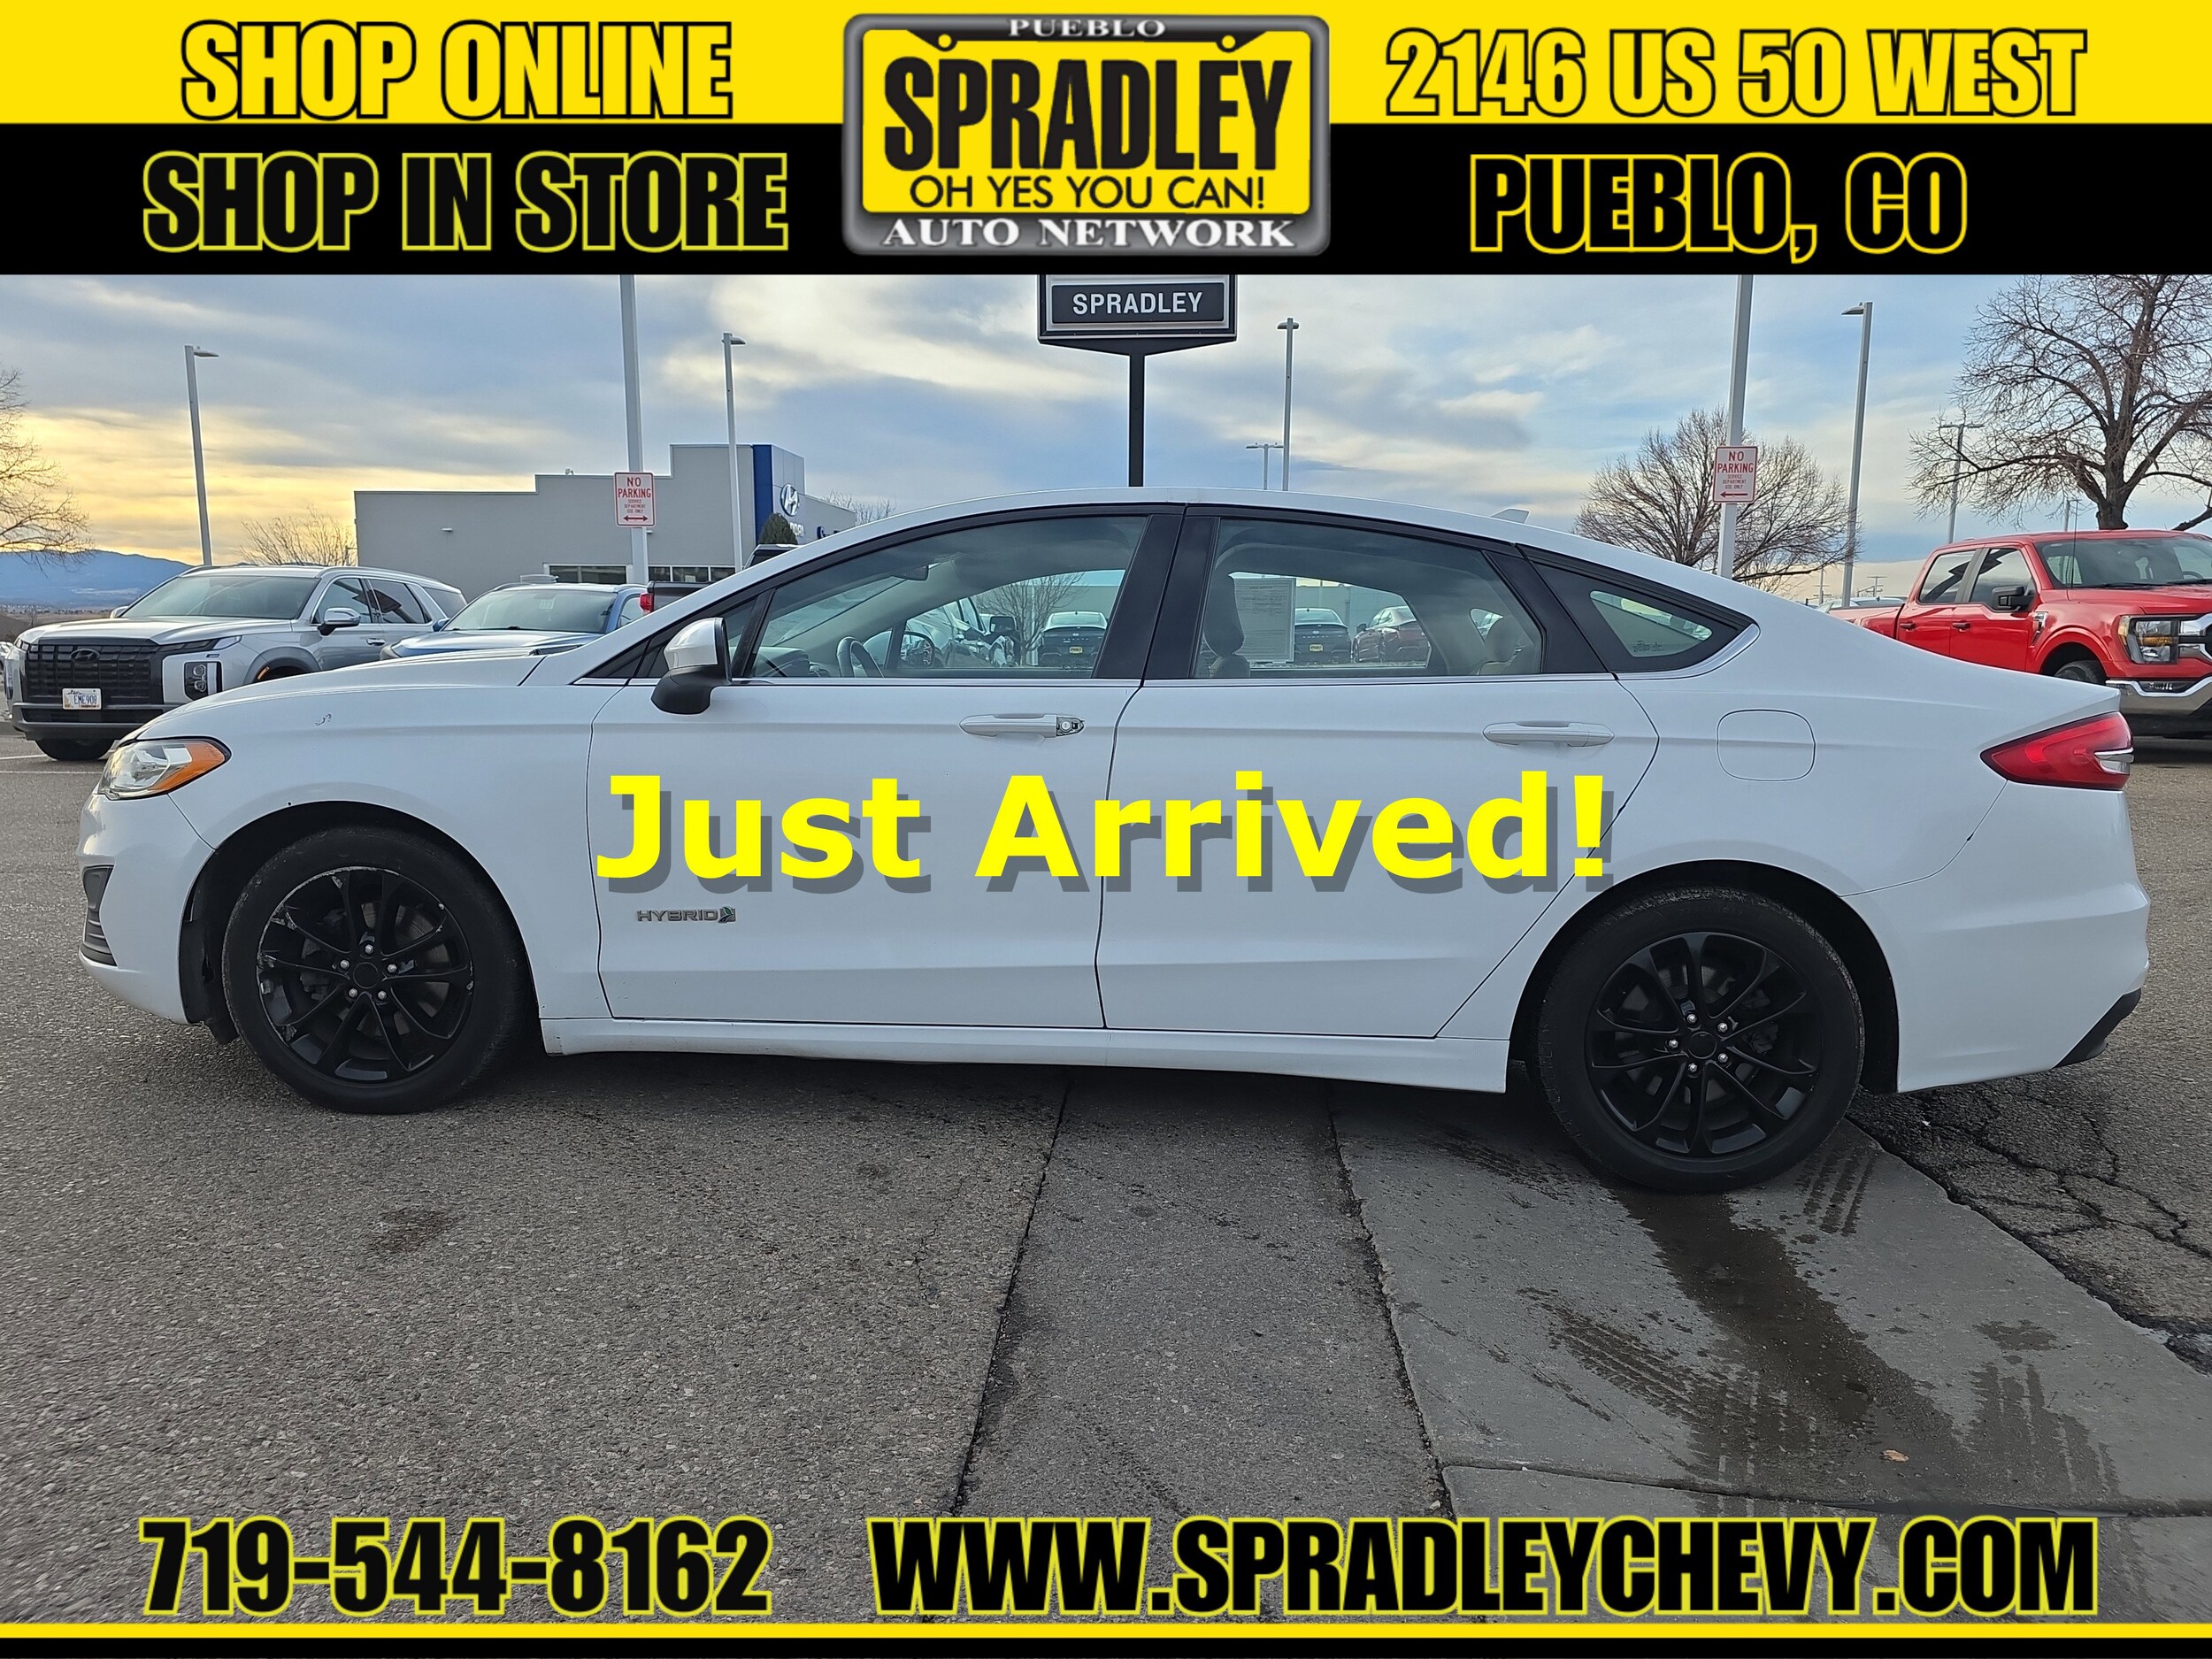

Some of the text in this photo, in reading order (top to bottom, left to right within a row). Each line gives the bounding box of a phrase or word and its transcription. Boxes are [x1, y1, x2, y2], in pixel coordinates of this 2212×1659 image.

[1072, 292, 1202, 315] SPRADLEY
[1728, 451, 1745, 461] NO
[1717, 463, 1754, 473] PARKING
[626, 477, 641, 487] NO
[618, 488, 651, 498] PARKING
[636, 909, 718, 922] HYBRID
